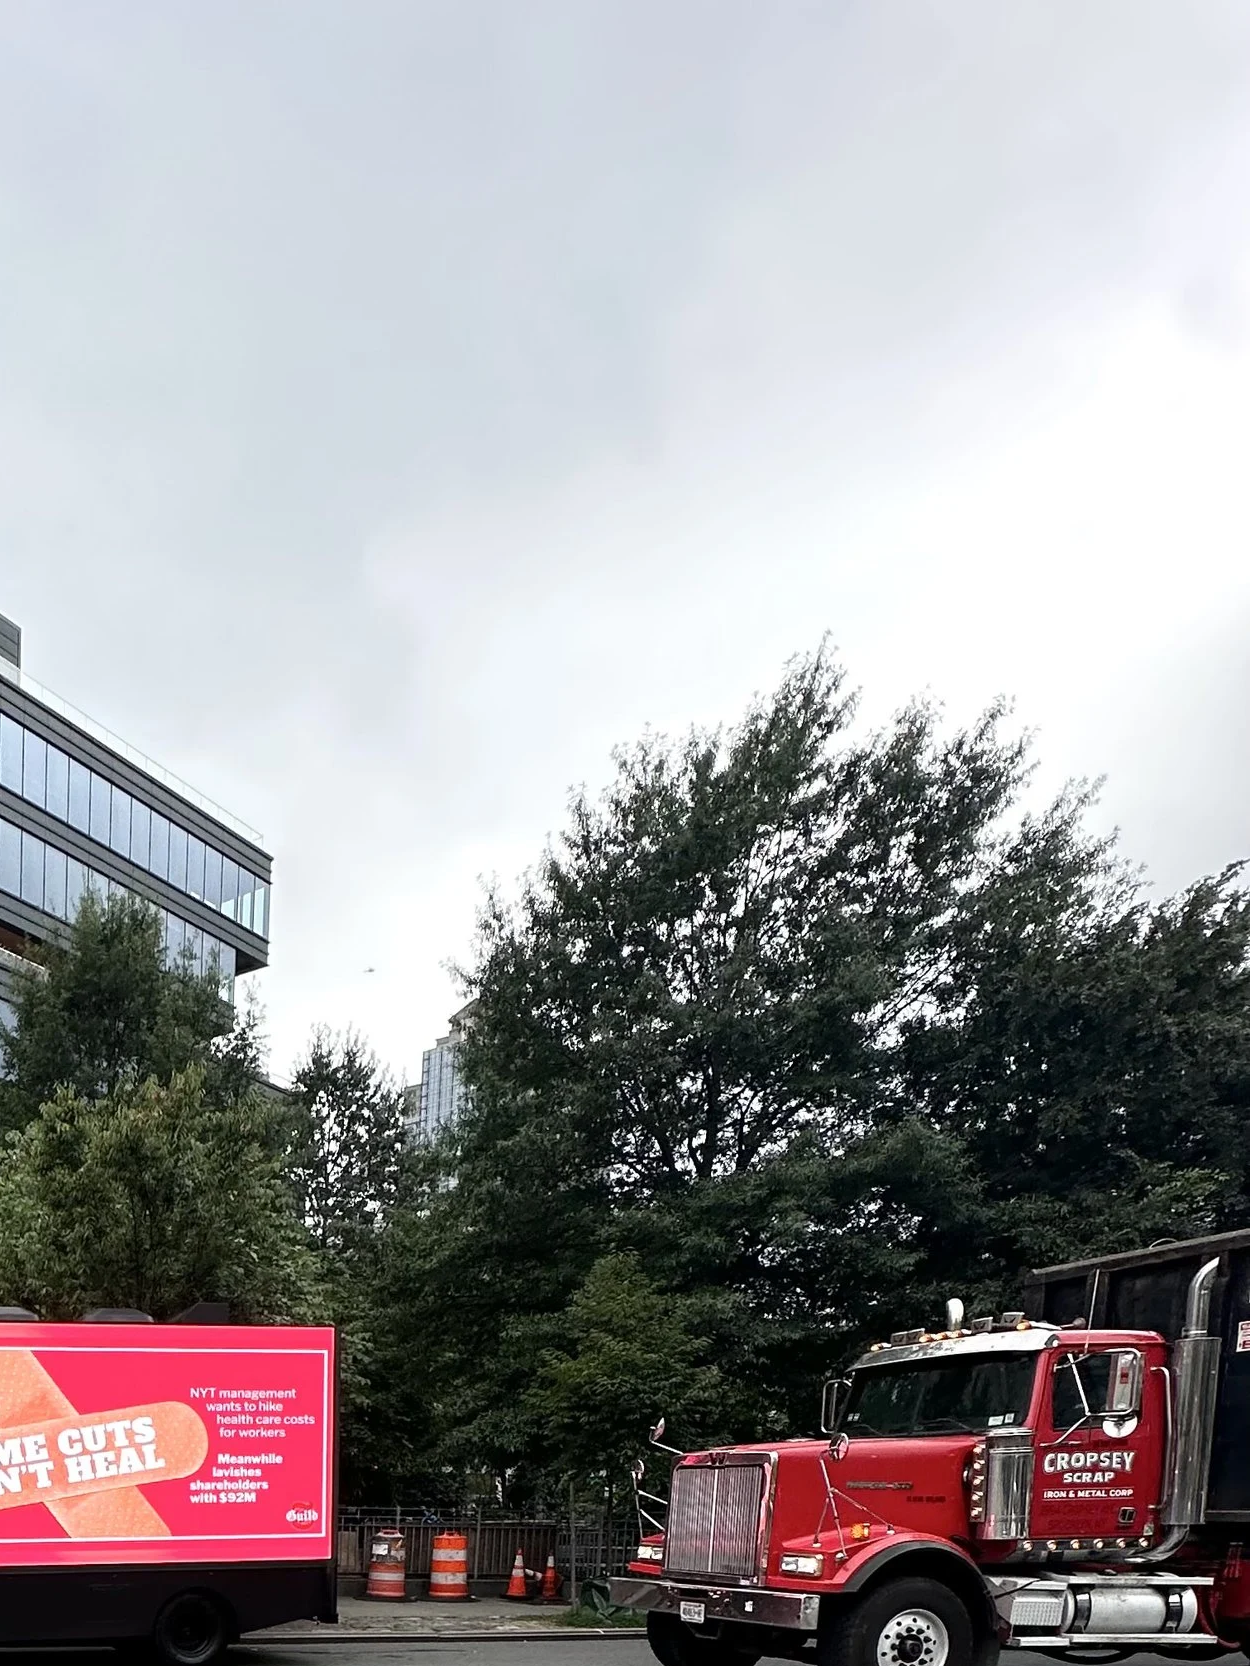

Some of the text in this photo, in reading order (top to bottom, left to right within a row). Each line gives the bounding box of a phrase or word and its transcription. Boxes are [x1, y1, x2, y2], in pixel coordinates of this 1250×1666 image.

[190, 1387, 296, 1400] NYT management
[206, 1401, 283, 1411] wants to hike
[216, 1414, 315, 1424] health care costs
[57, 1416, 156, 1456] CUTS
[219, 1427, 286, 1437] for workers
[64, 1443, 166, 1484] HEAL
[217, 1453, 283, 1464] Meanwhile
[1043, 1451, 1135, 1474] CROPSEY
[212, 1467, 262, 1477] lavishes
[1063, 1471, 1115, 1483] SCRAP
[189, 1480, 268, 1490] shareholders
[189, 1492, 257, 1503] with $92M
[1043, 1490, 1066, 1498] IRON
[1077, 1489, 1107, 1498] METAL
[1109, 1489, 1133, 1497] CORP
